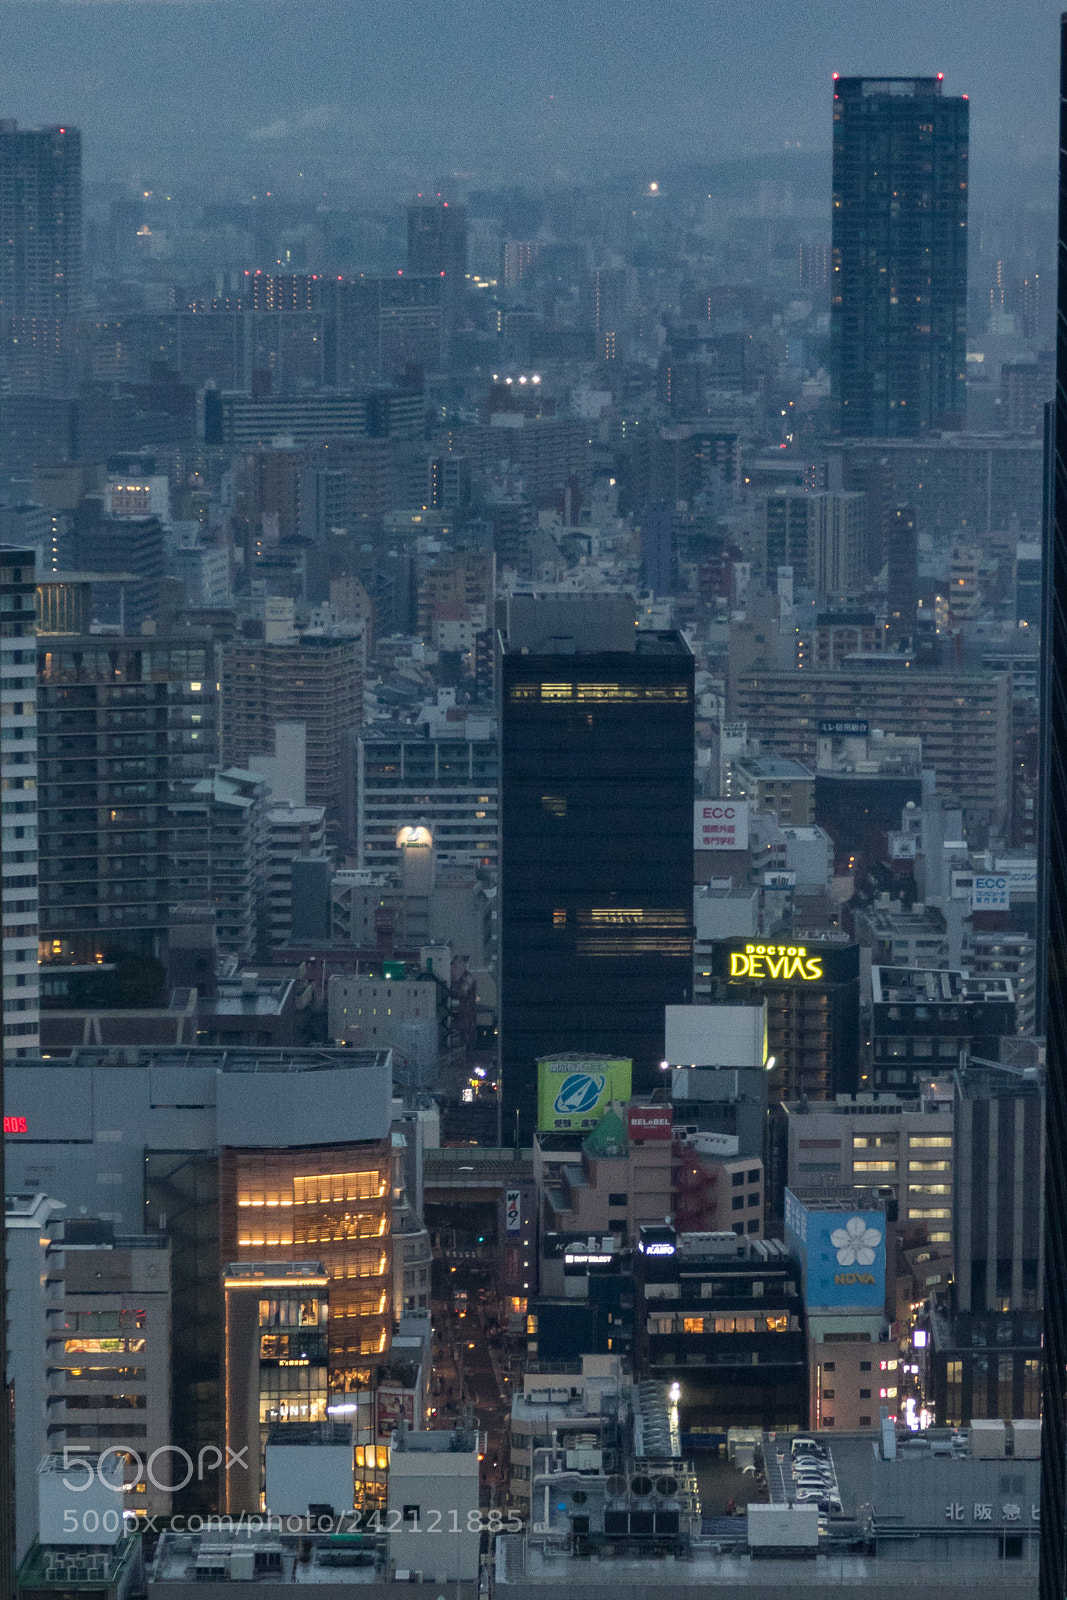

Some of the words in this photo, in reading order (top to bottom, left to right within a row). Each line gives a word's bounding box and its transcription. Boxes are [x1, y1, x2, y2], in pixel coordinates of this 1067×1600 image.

[702, 807, 736, 819] ECC
[702, 837, 736, 846] 専門学校
[976, 878, 1006, 889] ECC
[745, 944, 807, 957] DOCTOR
[730, 952, 823, 980] DEVIAS
[834, 1272, 876, 1285] NOVA
